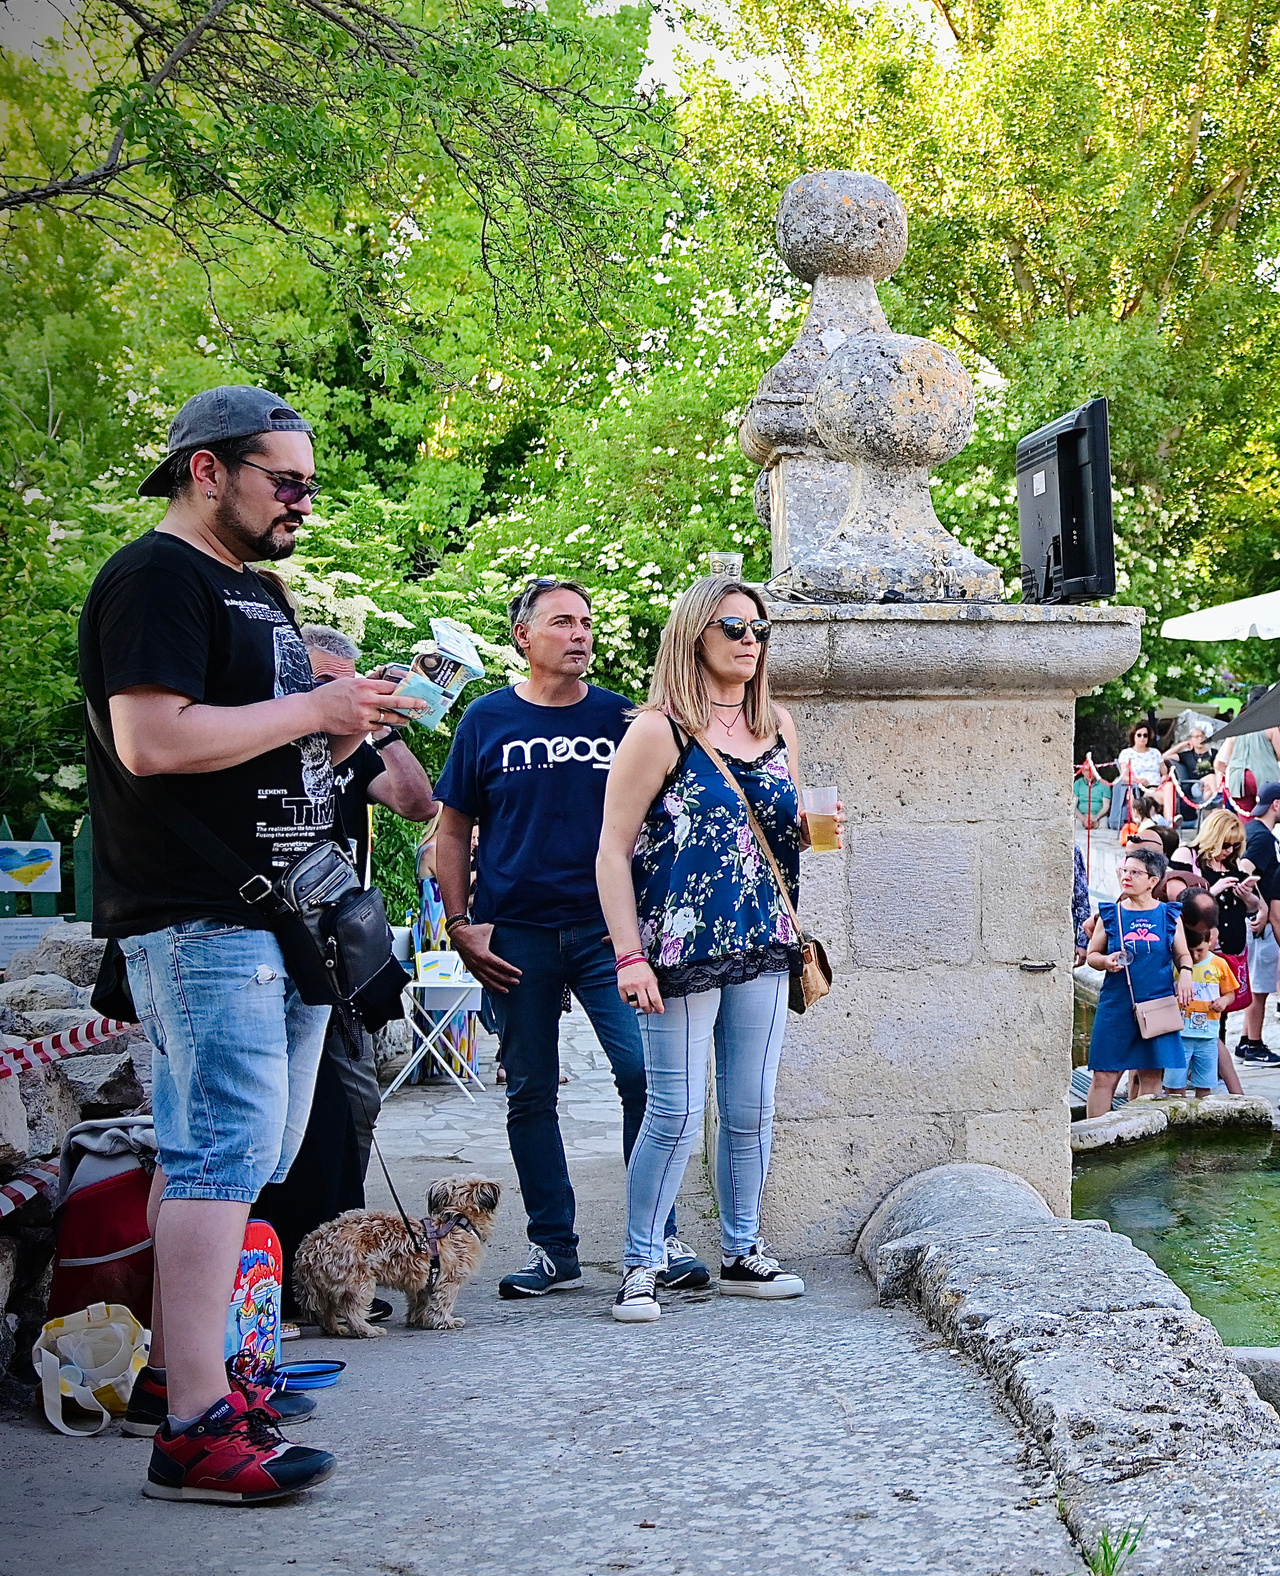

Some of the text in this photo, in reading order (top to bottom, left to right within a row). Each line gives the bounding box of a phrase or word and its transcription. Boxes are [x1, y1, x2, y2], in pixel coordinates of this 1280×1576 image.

[502, 736, 616, 769] moog
[240, 1248, 269, 1276] SUPER
[209, 1403, 230, 1420] INSIDE
